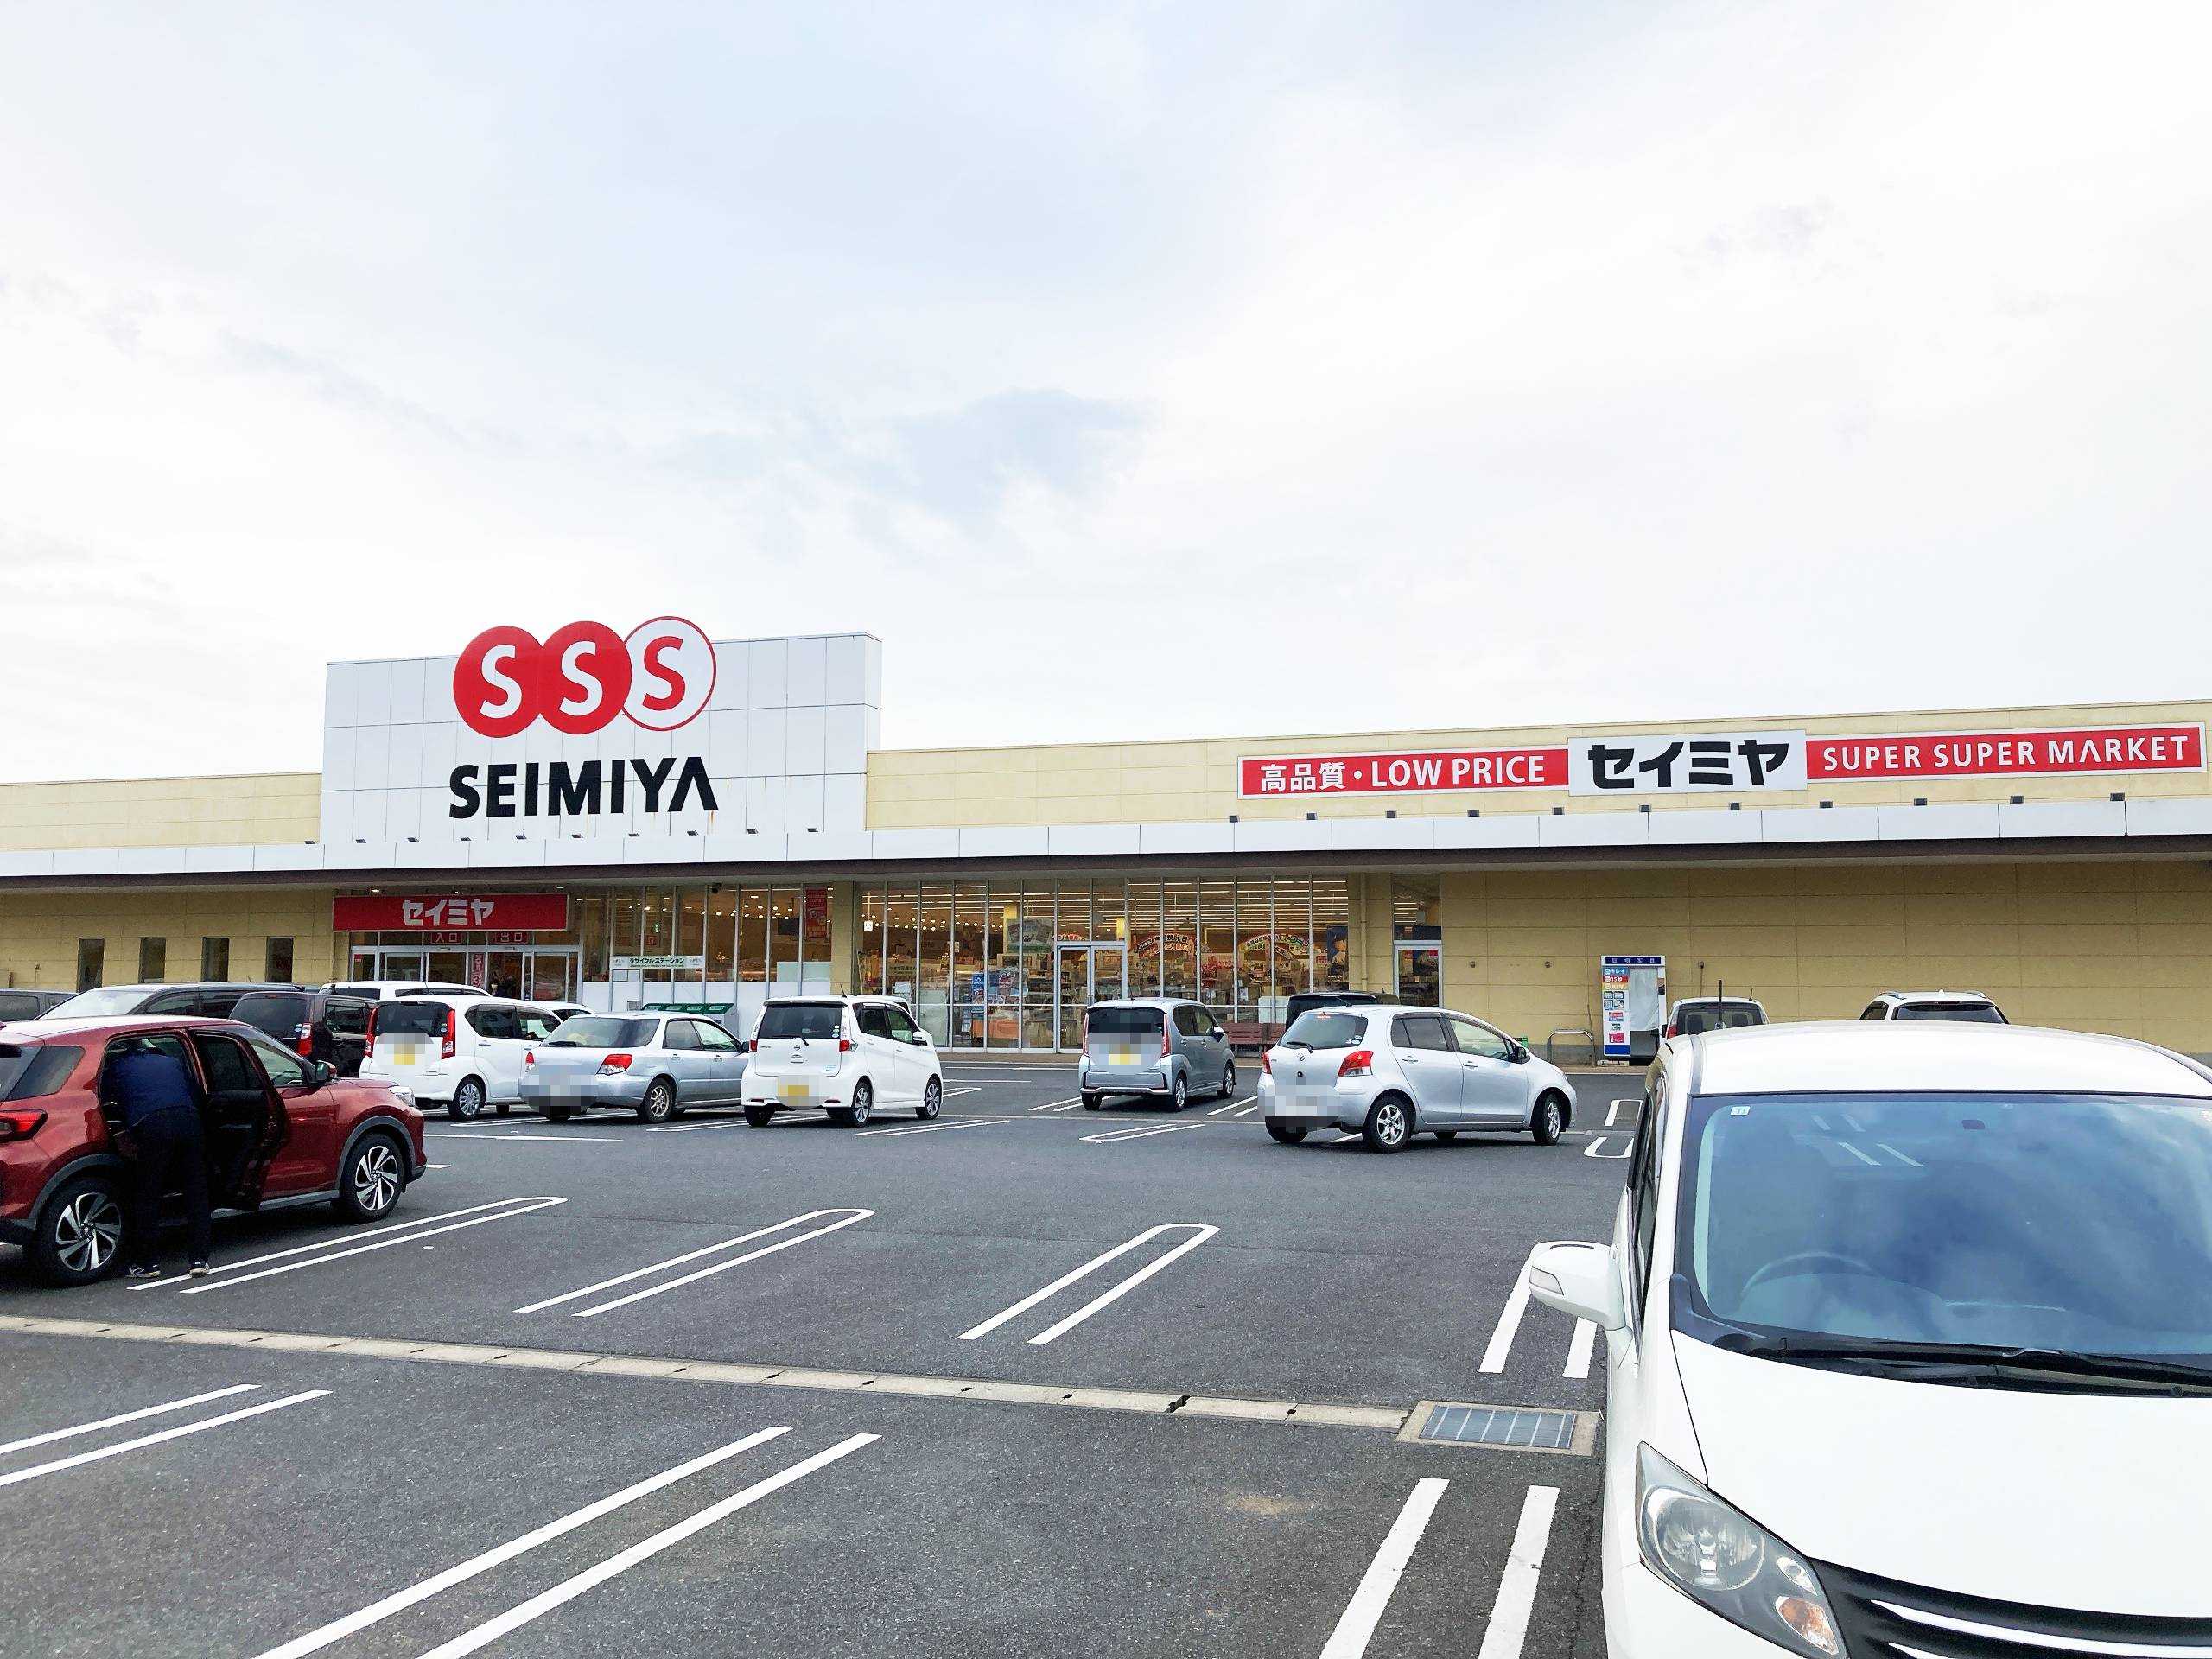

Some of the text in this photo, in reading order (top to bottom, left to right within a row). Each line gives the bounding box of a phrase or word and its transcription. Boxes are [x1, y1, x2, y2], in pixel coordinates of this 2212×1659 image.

[1588, 740, 1789, 788] セイミヤ
[1823, 735, 2188, 771] SUPER SUPER MARKET
[1452, 755, 1544, 785] PRICE
[449, 756, 719, 819] SEIMIYA
[402, 899, 494, 926] セイミヤ
[435, 932, 457, 943] 入口
[499, 931, 523, 943] 出口
